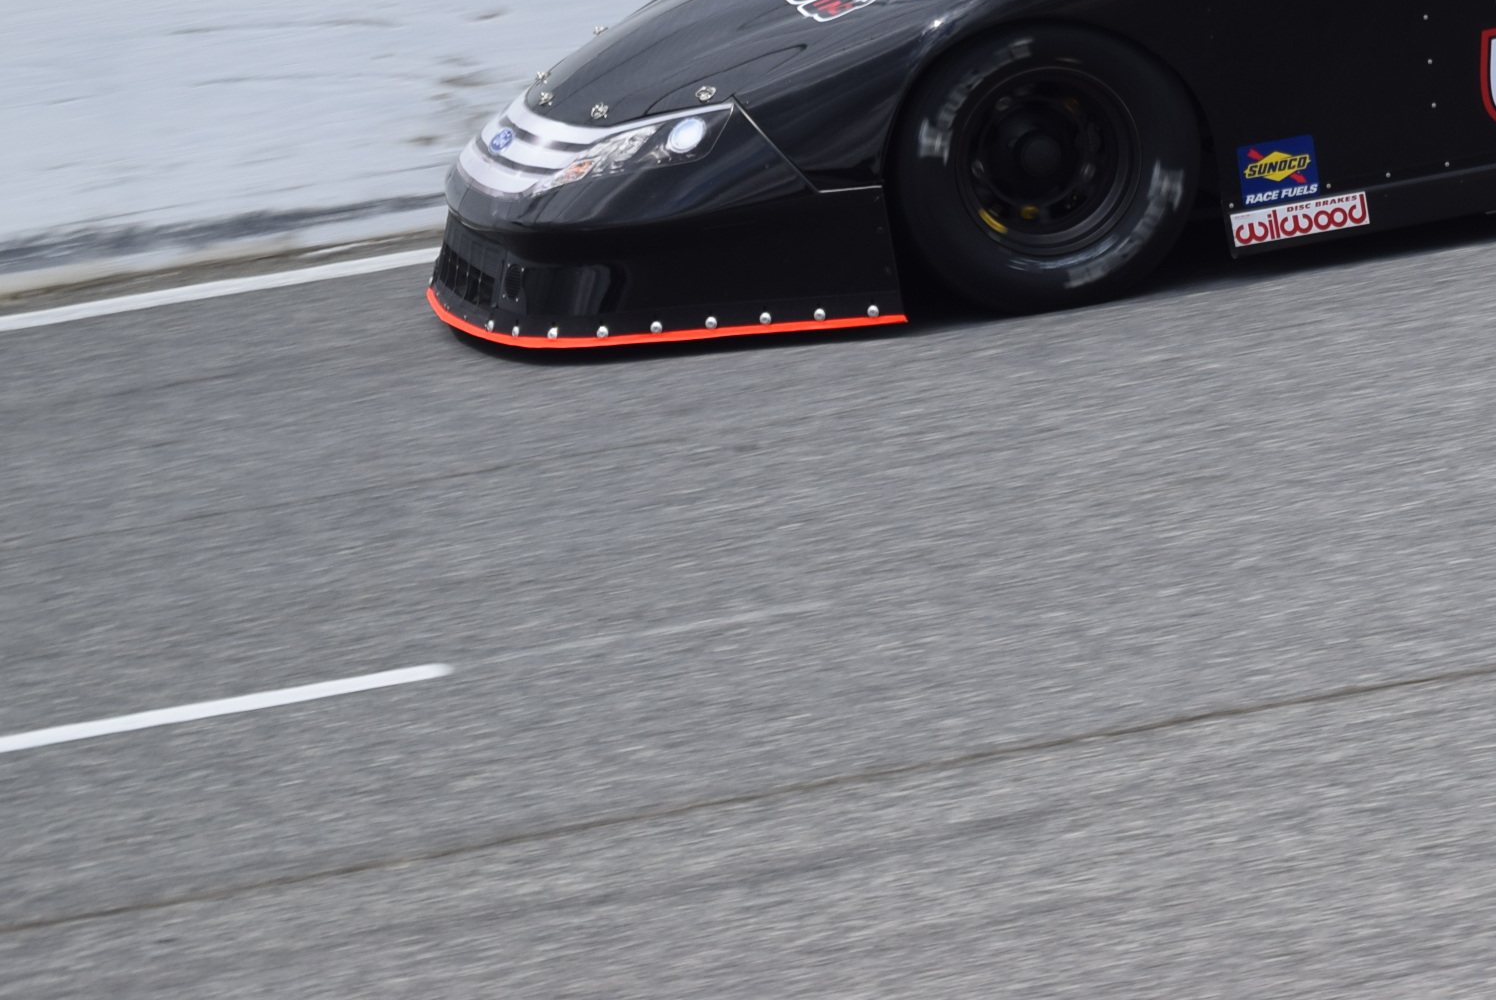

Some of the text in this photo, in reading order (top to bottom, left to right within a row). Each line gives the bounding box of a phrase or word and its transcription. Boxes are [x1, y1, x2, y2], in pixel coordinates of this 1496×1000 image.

[1247, 156, 1308, 177] SUNOCO
[1245, 183, 1318, 205] RACE FUELS
[1287, 194, 1358, 213] DISC BRAKES
[1235, 193, 1367, 245] wilwood
